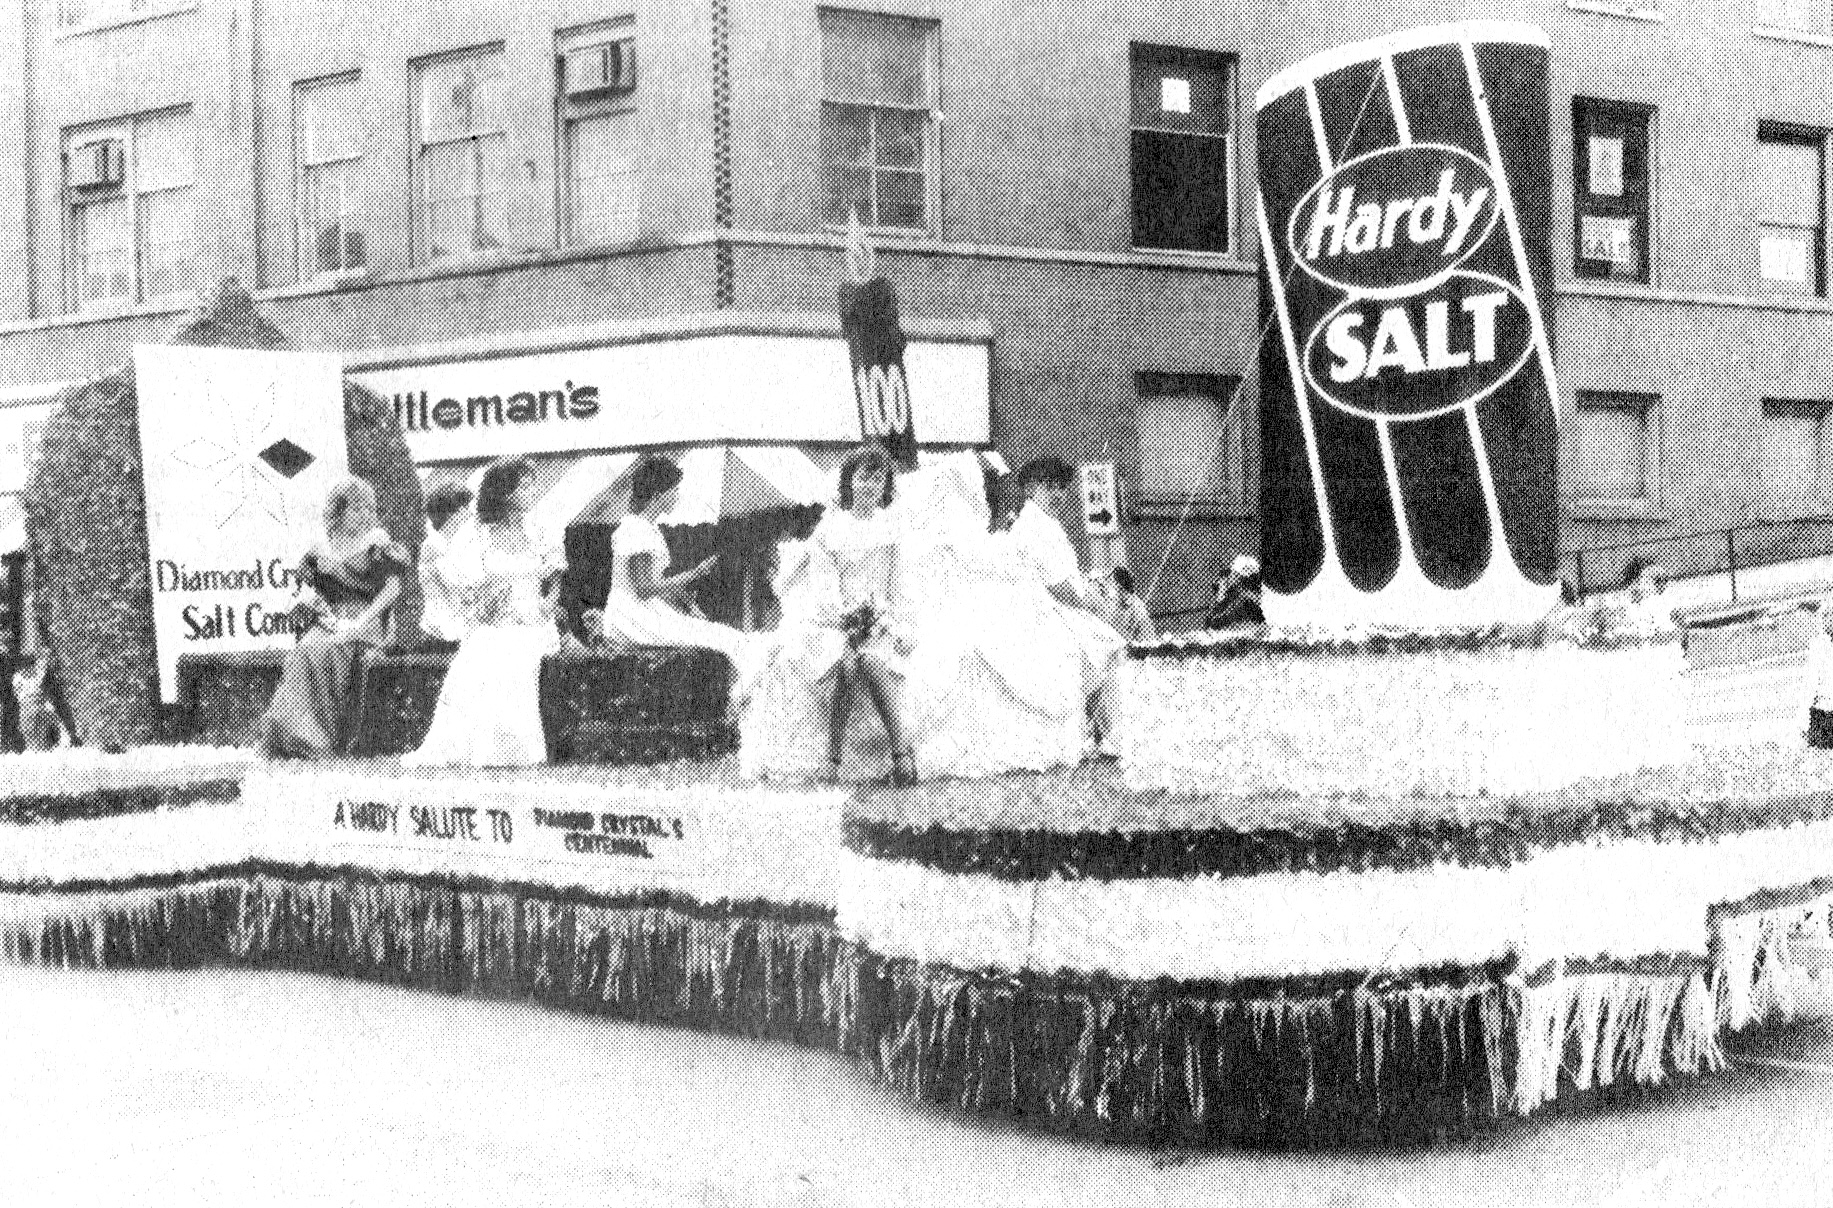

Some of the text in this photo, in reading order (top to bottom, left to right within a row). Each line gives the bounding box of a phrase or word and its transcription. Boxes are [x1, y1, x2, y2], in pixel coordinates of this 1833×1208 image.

[1305, 168, 1490, 260] Hardy
[1325, 290, 1509, 383] SALT
[856, 364, 908, 435] 100
[156, 557, 303, 598] Diamond Cry
[182, 602, 306, 643] Salt Comp
[333, 799, 513, 844] A HARDY SALUTE TO
